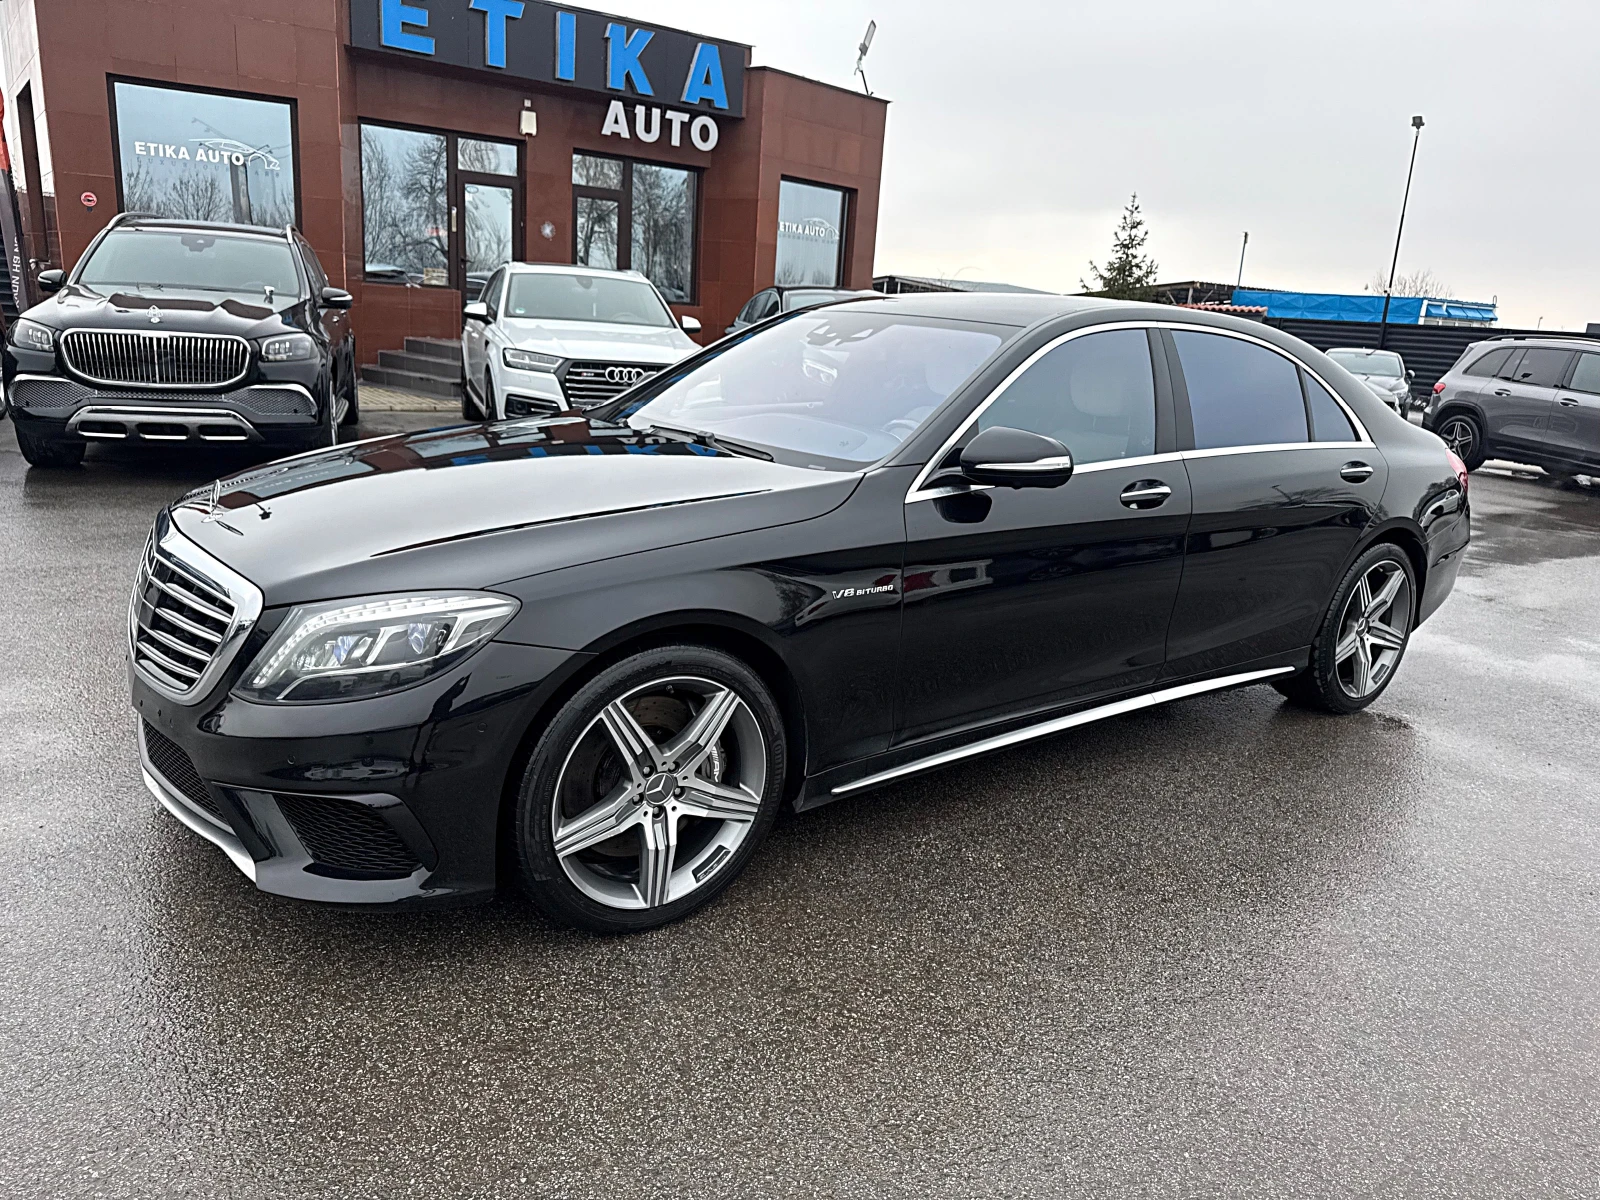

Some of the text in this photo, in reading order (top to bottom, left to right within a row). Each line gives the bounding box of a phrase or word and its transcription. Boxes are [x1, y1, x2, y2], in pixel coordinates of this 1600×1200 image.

[379, 0, 729, 109] ETIKA
[601, 99, 719, 152] AUTO
[134, 141, 245, 166] ETIKA AUTO
[779, 221, 826, 237] ETIKA AUTO
[832, 585, 894, 599] V8 BITURBO
